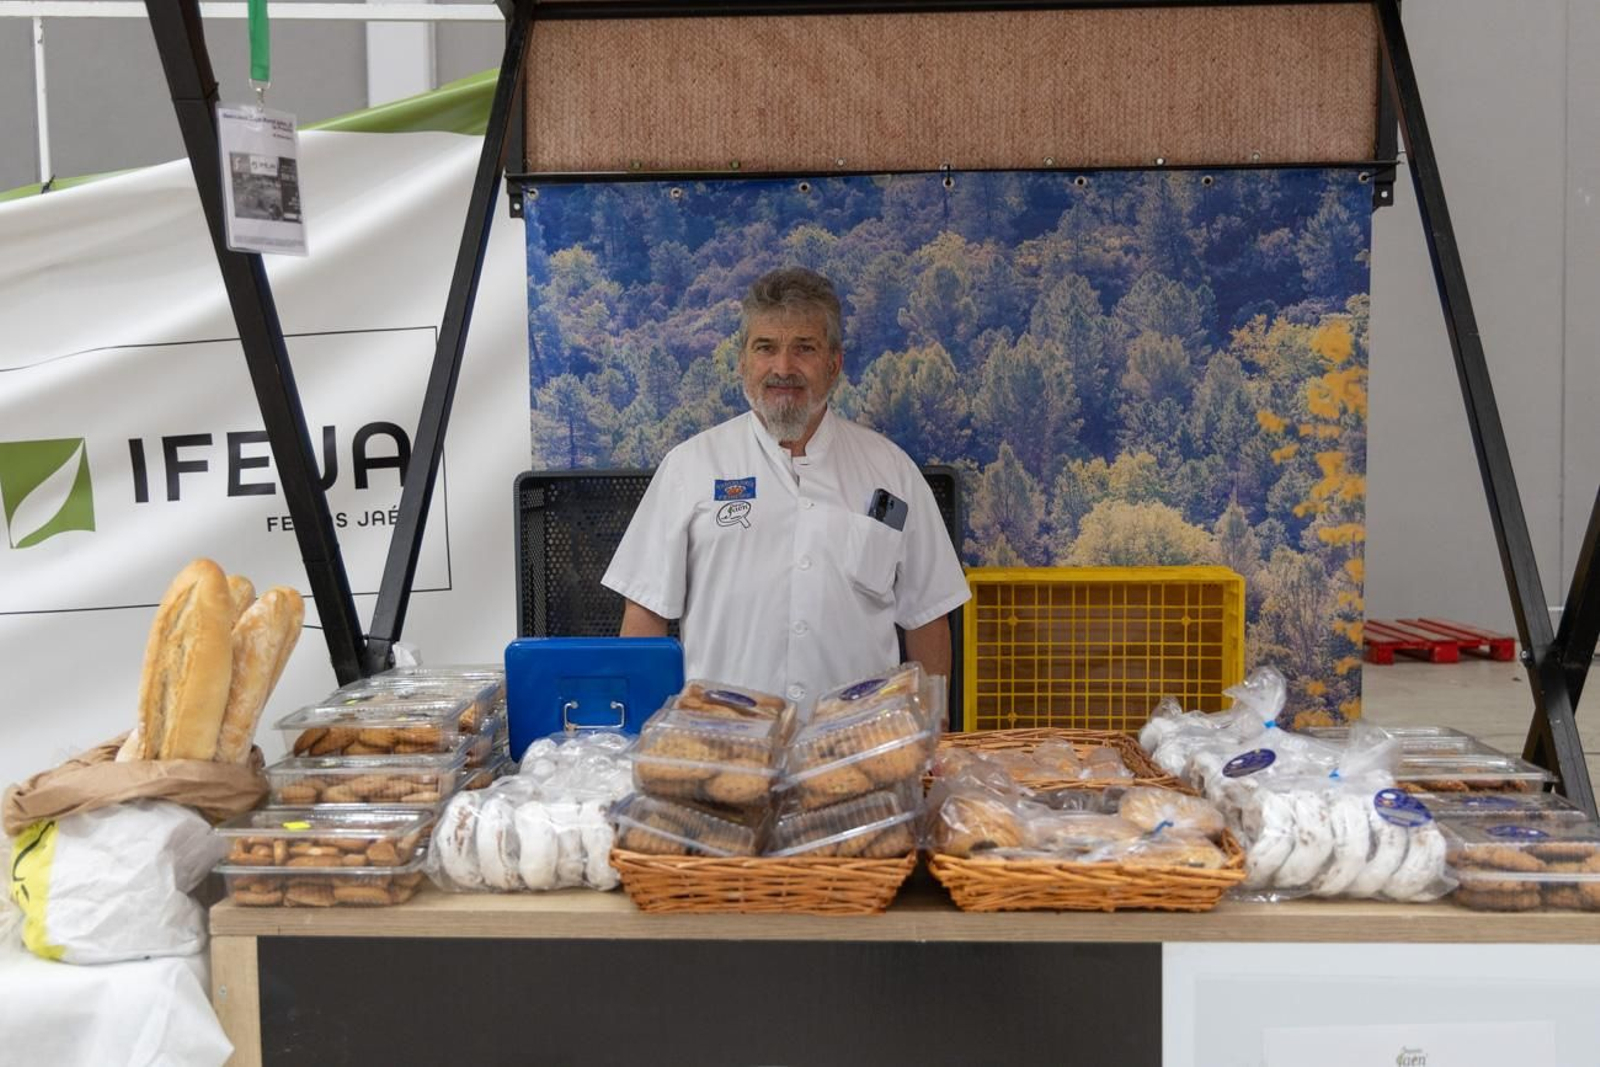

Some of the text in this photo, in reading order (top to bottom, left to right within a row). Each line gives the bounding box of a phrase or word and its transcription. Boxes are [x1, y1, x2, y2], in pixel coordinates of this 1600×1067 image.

[128, 421, 411, 503] IFEJA
[267, 505, 400, 532] FES JAÉ
